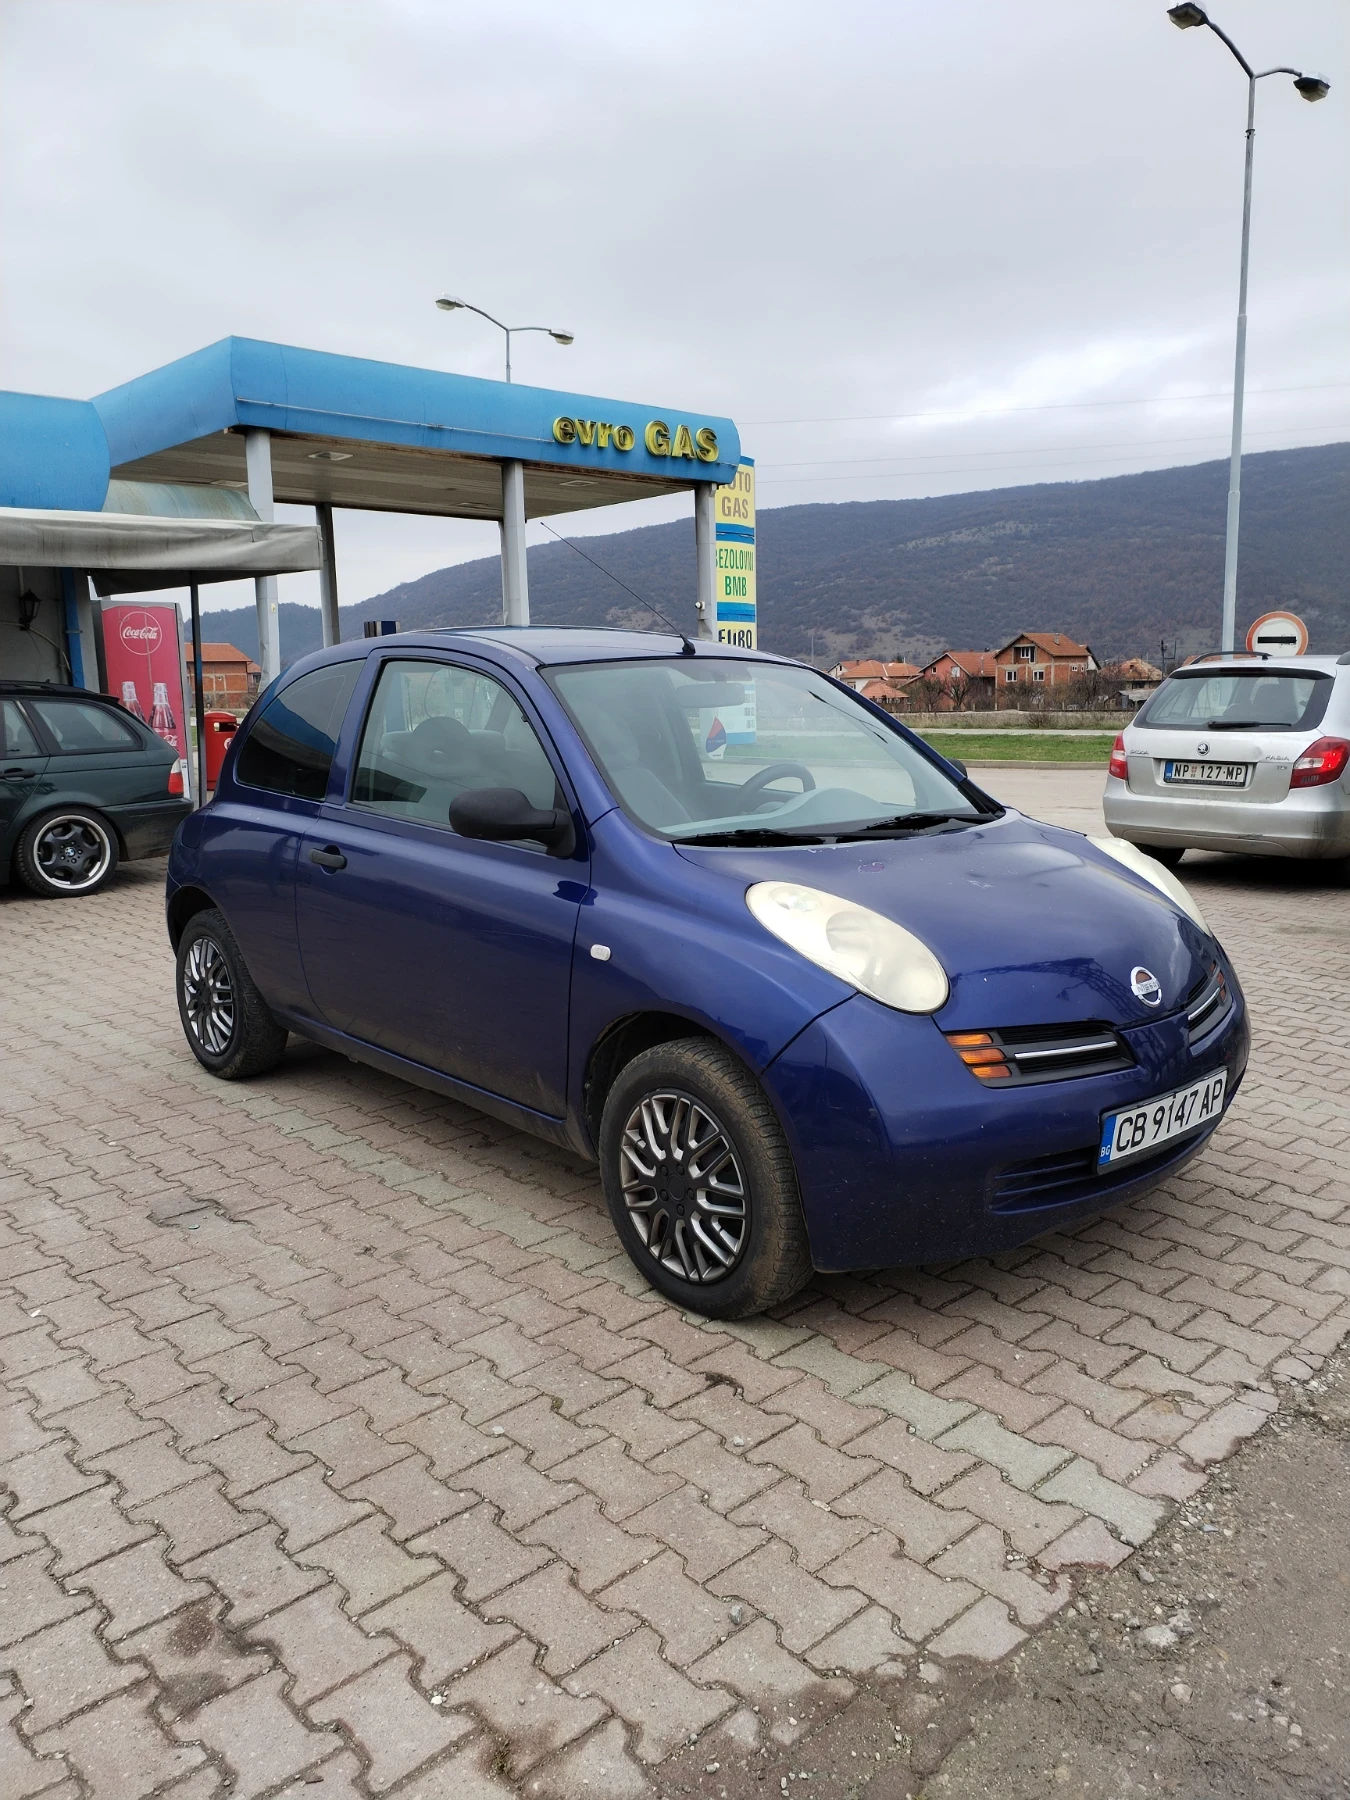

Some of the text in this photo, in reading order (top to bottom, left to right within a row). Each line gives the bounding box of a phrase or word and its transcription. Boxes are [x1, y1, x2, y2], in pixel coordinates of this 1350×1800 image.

[553, 416, 720, 463] evro GAS
[721, 495, 749, 520] GAS
[724, 575, 748, 597] BMB
[122, 626, 159, 640] Coca-Cola
[1173, 763, 1190, 778] NP
[1115, 1078, 1223, 1153] CB 9147 AP
[1100, 1144, 1111, 1158] BG
